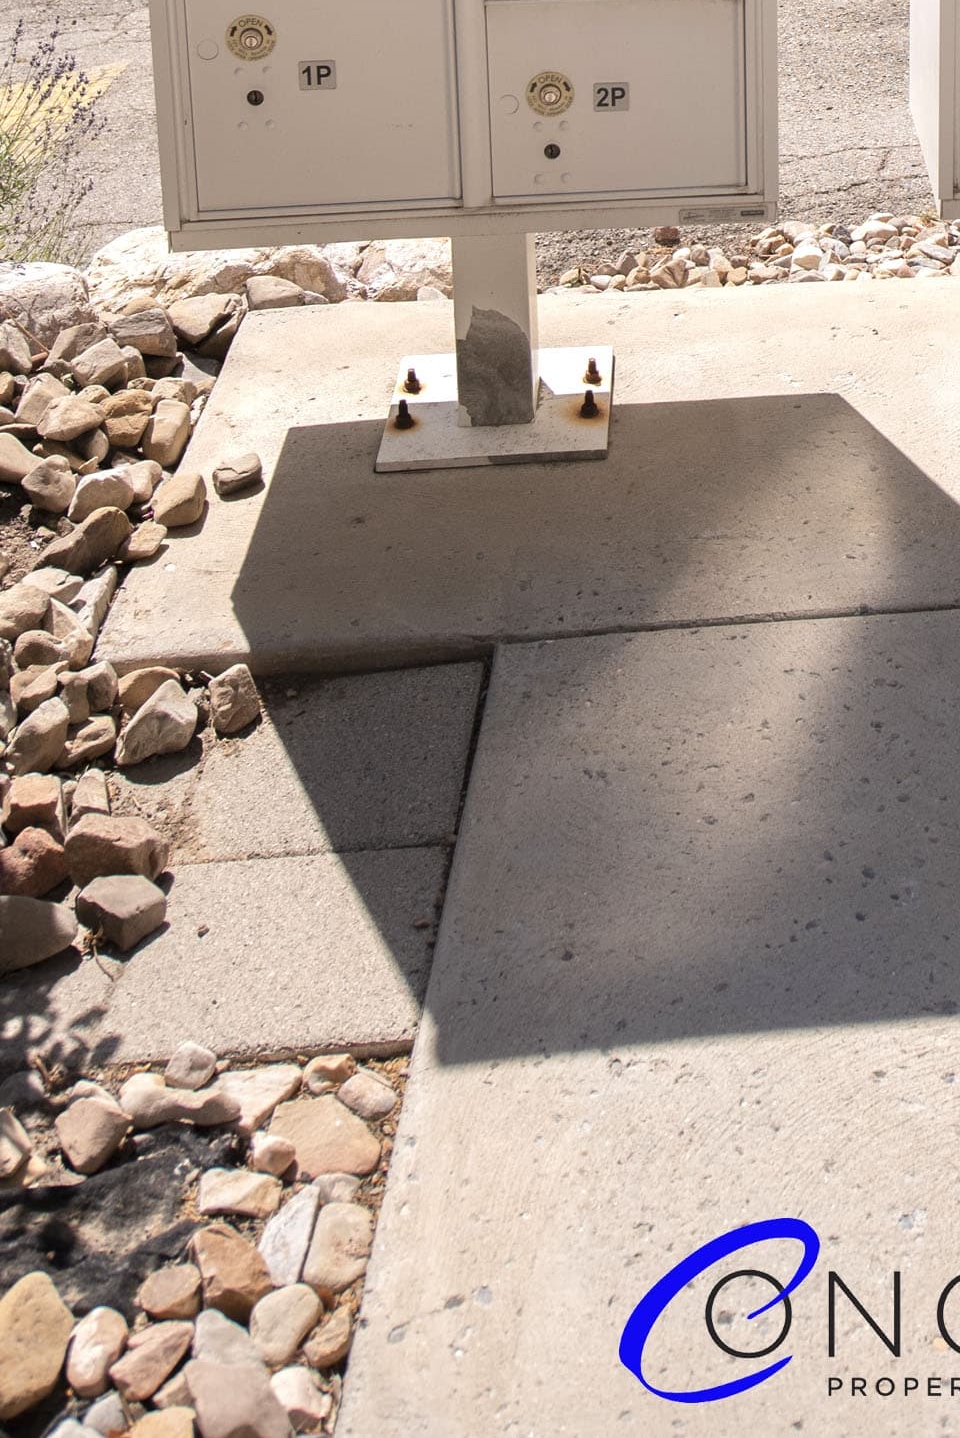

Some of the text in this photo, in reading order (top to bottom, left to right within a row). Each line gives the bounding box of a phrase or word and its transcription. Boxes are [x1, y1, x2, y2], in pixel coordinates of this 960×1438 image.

[238, 17, 264, 27] OPEN
[302, 65, 332, 86] 1P
[538, 74, 562, 84] OPEN
[596, 87, 626, 107] 2P
